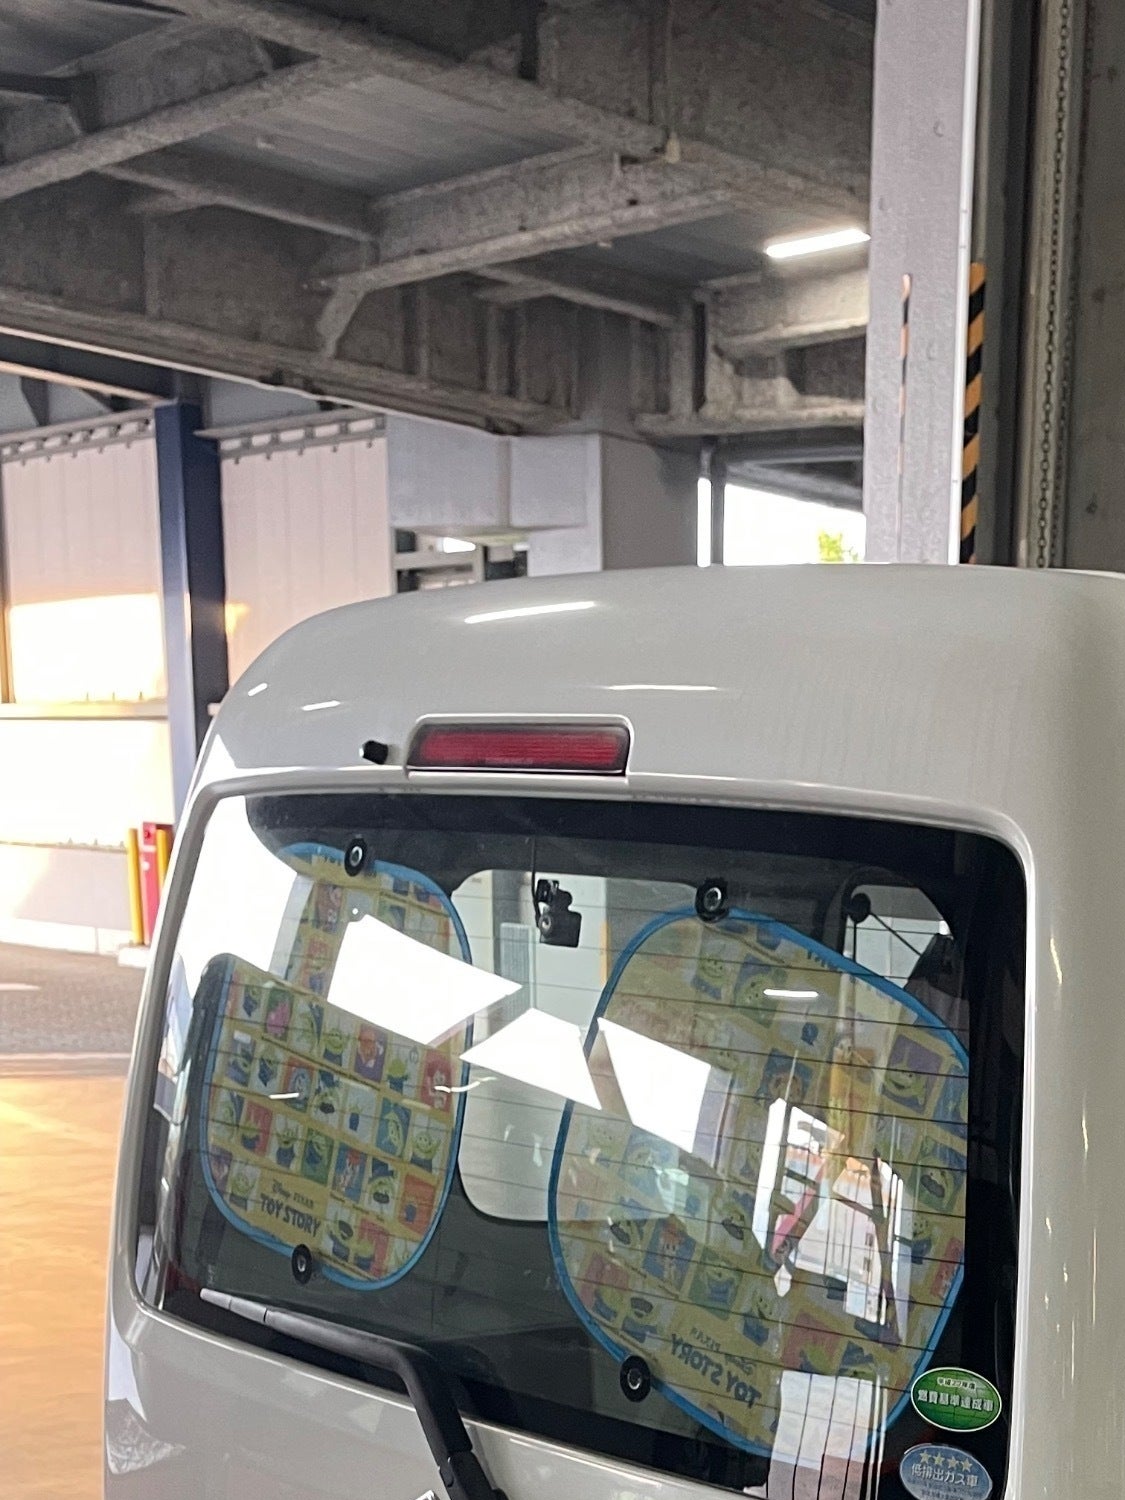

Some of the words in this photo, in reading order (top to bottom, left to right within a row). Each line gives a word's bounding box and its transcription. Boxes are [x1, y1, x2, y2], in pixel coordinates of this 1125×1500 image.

[260, 1193, 283, 1219] TOY
[282, 1205, 321, 1237] STORY
[911, 1463, 979, 1488] 低排出ガス車
